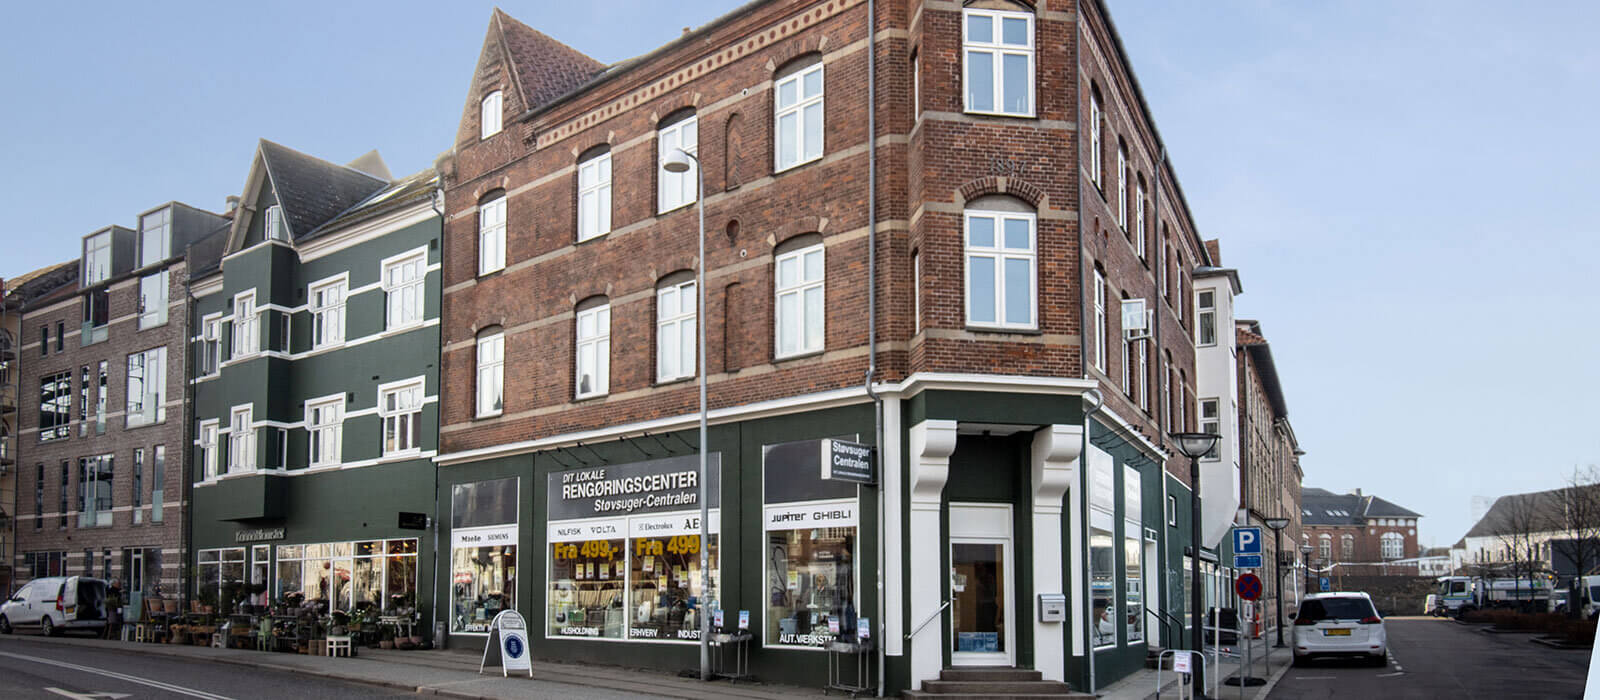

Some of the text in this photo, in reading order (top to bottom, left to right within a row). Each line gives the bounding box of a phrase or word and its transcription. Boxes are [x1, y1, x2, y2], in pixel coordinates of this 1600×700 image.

[832, 441, 869, 458] Støvsuger
[833, 454, 869, 470] Centralen
[562, 469, 605, 483] DIT LOKALE
[562, 471, 697, 499] RENGØRINGSCENTER
[594, 491, 697, 512] Støvsuger-Centralen
[813, 510, 852, 520] GHIBLI
[590, 525, 616, 534] VOLTA
[645, 522, 673, 531] Electrolux
[684, 518, 702, 530] AE
[558, 527, 582, 536] NILFISK
[636, 535, 711, 556] Fra 499
[1239, 531, 1255, 552] P
[554, 542, 578, 560] Fra
[561, 627, 599, 636] HUSHOLDNING
[630, 628, 658, 638] ERHVERV
[678, 629, 701, 639] INDUST
